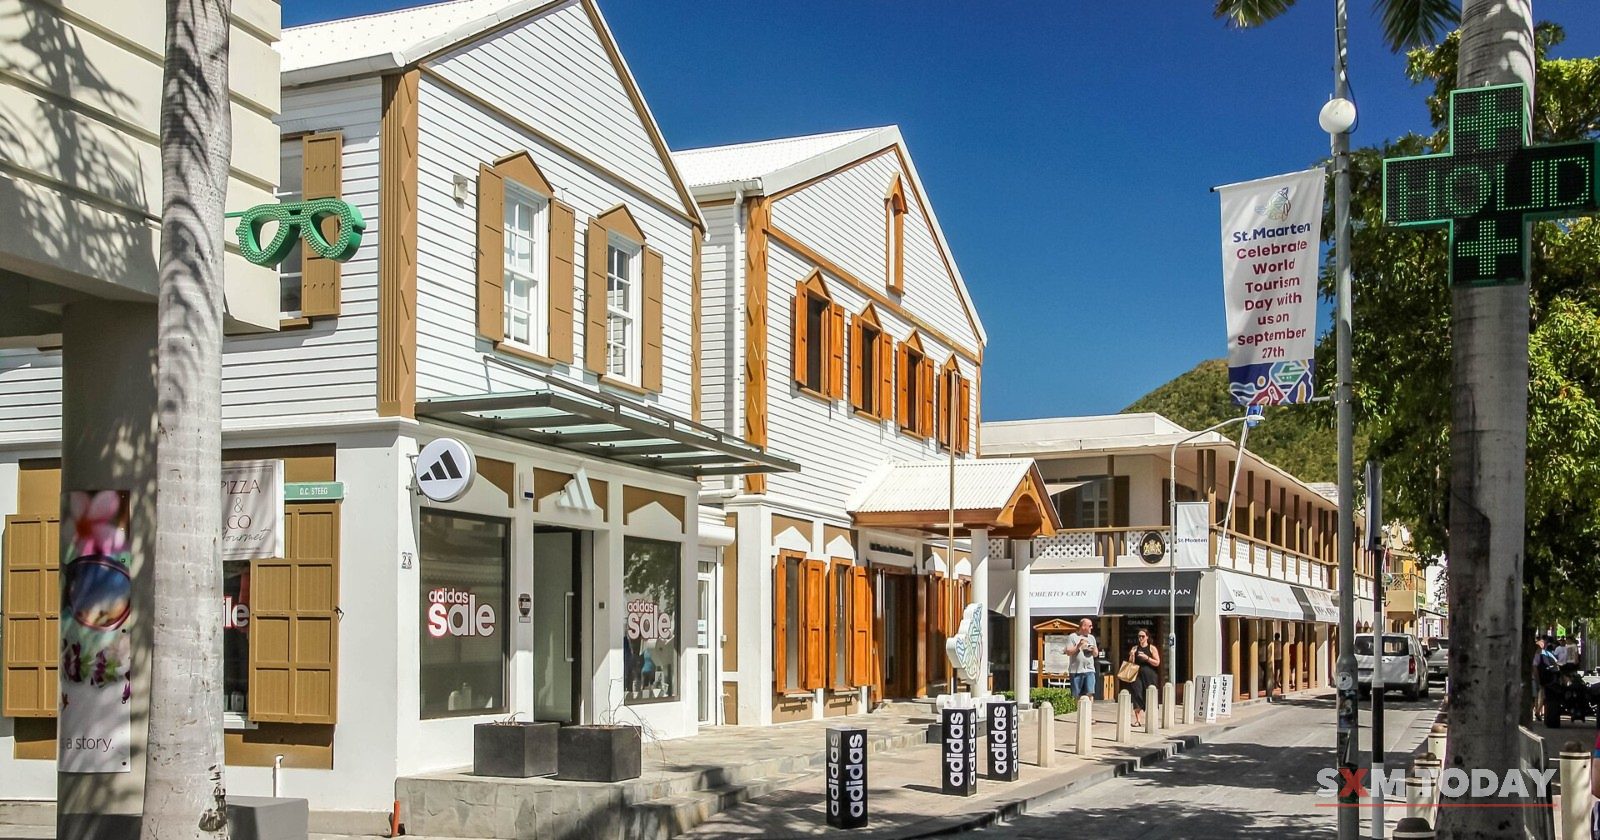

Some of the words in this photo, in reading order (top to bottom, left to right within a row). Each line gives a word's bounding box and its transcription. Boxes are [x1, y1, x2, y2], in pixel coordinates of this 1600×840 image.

[1236, 240, 1307, 260] Celebrate
[1252, 258, 1296, 275] World
[1245, 276, 1300, 293] Tourism
[1244, 298, 1273, 311] Day
[1276, 292, 1302, 306] with
[1237, 328, 1307, 346] September
[1262, 347, 1285, 359] 27th
[311, 487, 328, 495] STEEG
[234, 497, 244, 513] &
[227, 514, 252, 530] CO
[428, 587, 469, 604] adidas
[428, 593, 496, 637] sale
[627, 599, 654, 613] adidas
[627, 604, 671, 640] sale
[66, 737, 73, 750] a
[75, 735, 115, 753] story.
[968, 711, 976, 786] adidas
[991, 705, 1007, 774] adidas
[947, 712, 964, 787] adidas
[828, 734, 839, 817] adidas
[846, 733, 863, 818] adidas
